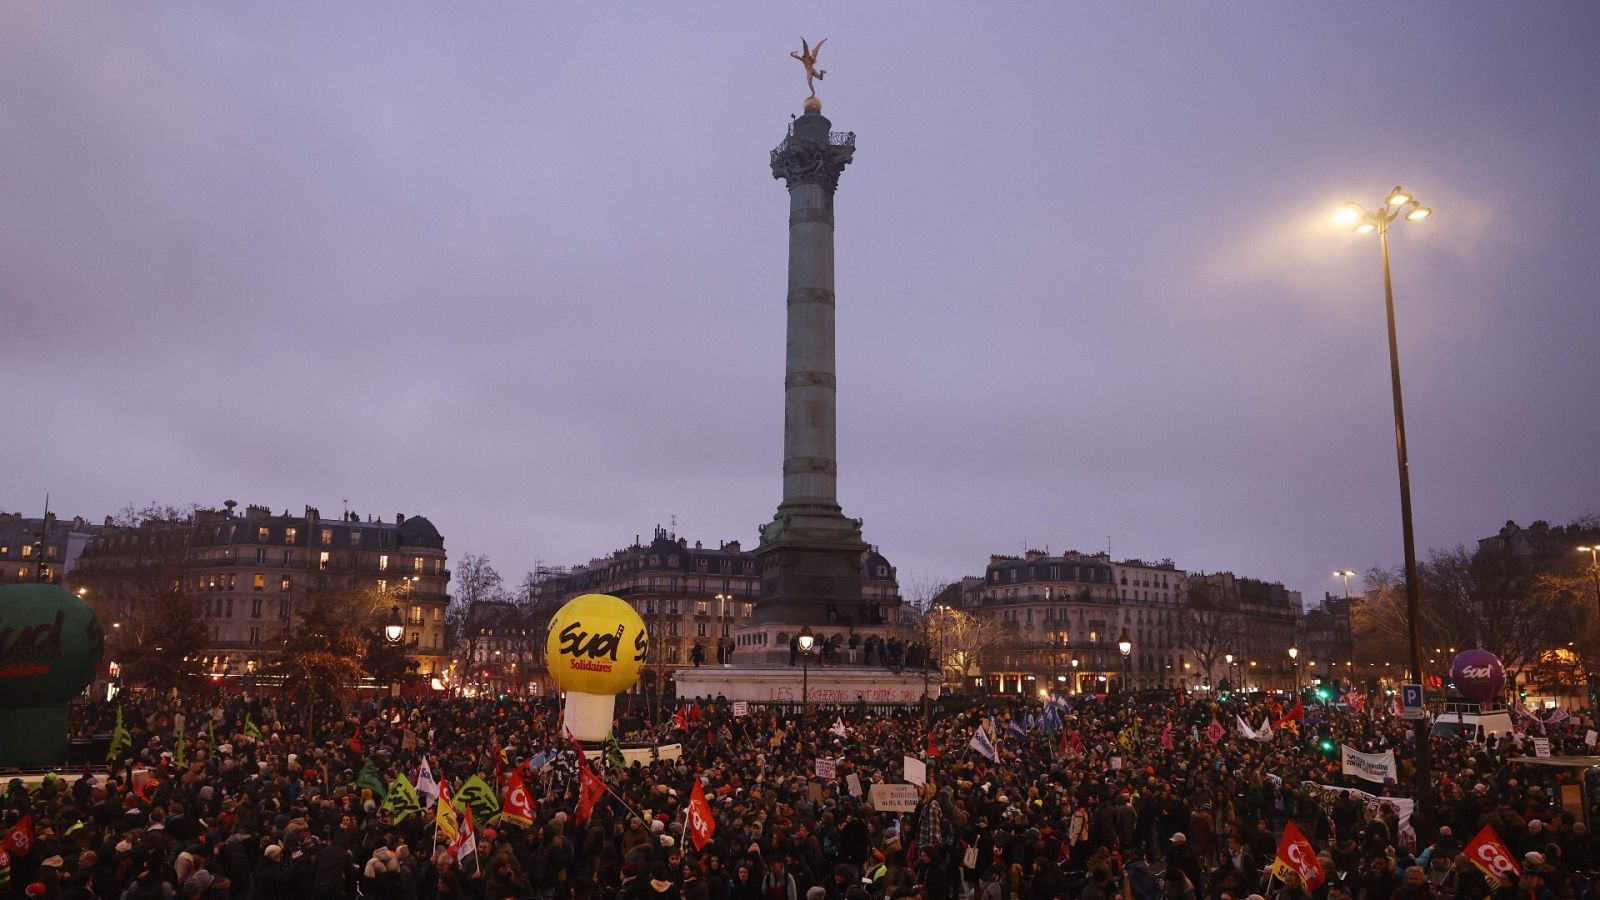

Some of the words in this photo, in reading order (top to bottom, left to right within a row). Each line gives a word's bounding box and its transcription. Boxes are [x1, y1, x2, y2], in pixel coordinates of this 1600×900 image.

[559, 622, 626, 662] Sud
[570, 659, 613, 673] Solidaires
[1462, 664, 1493, 679] Sud
[770, 687, 793, 702] LES
[1407, 689, 1417, 704] P
